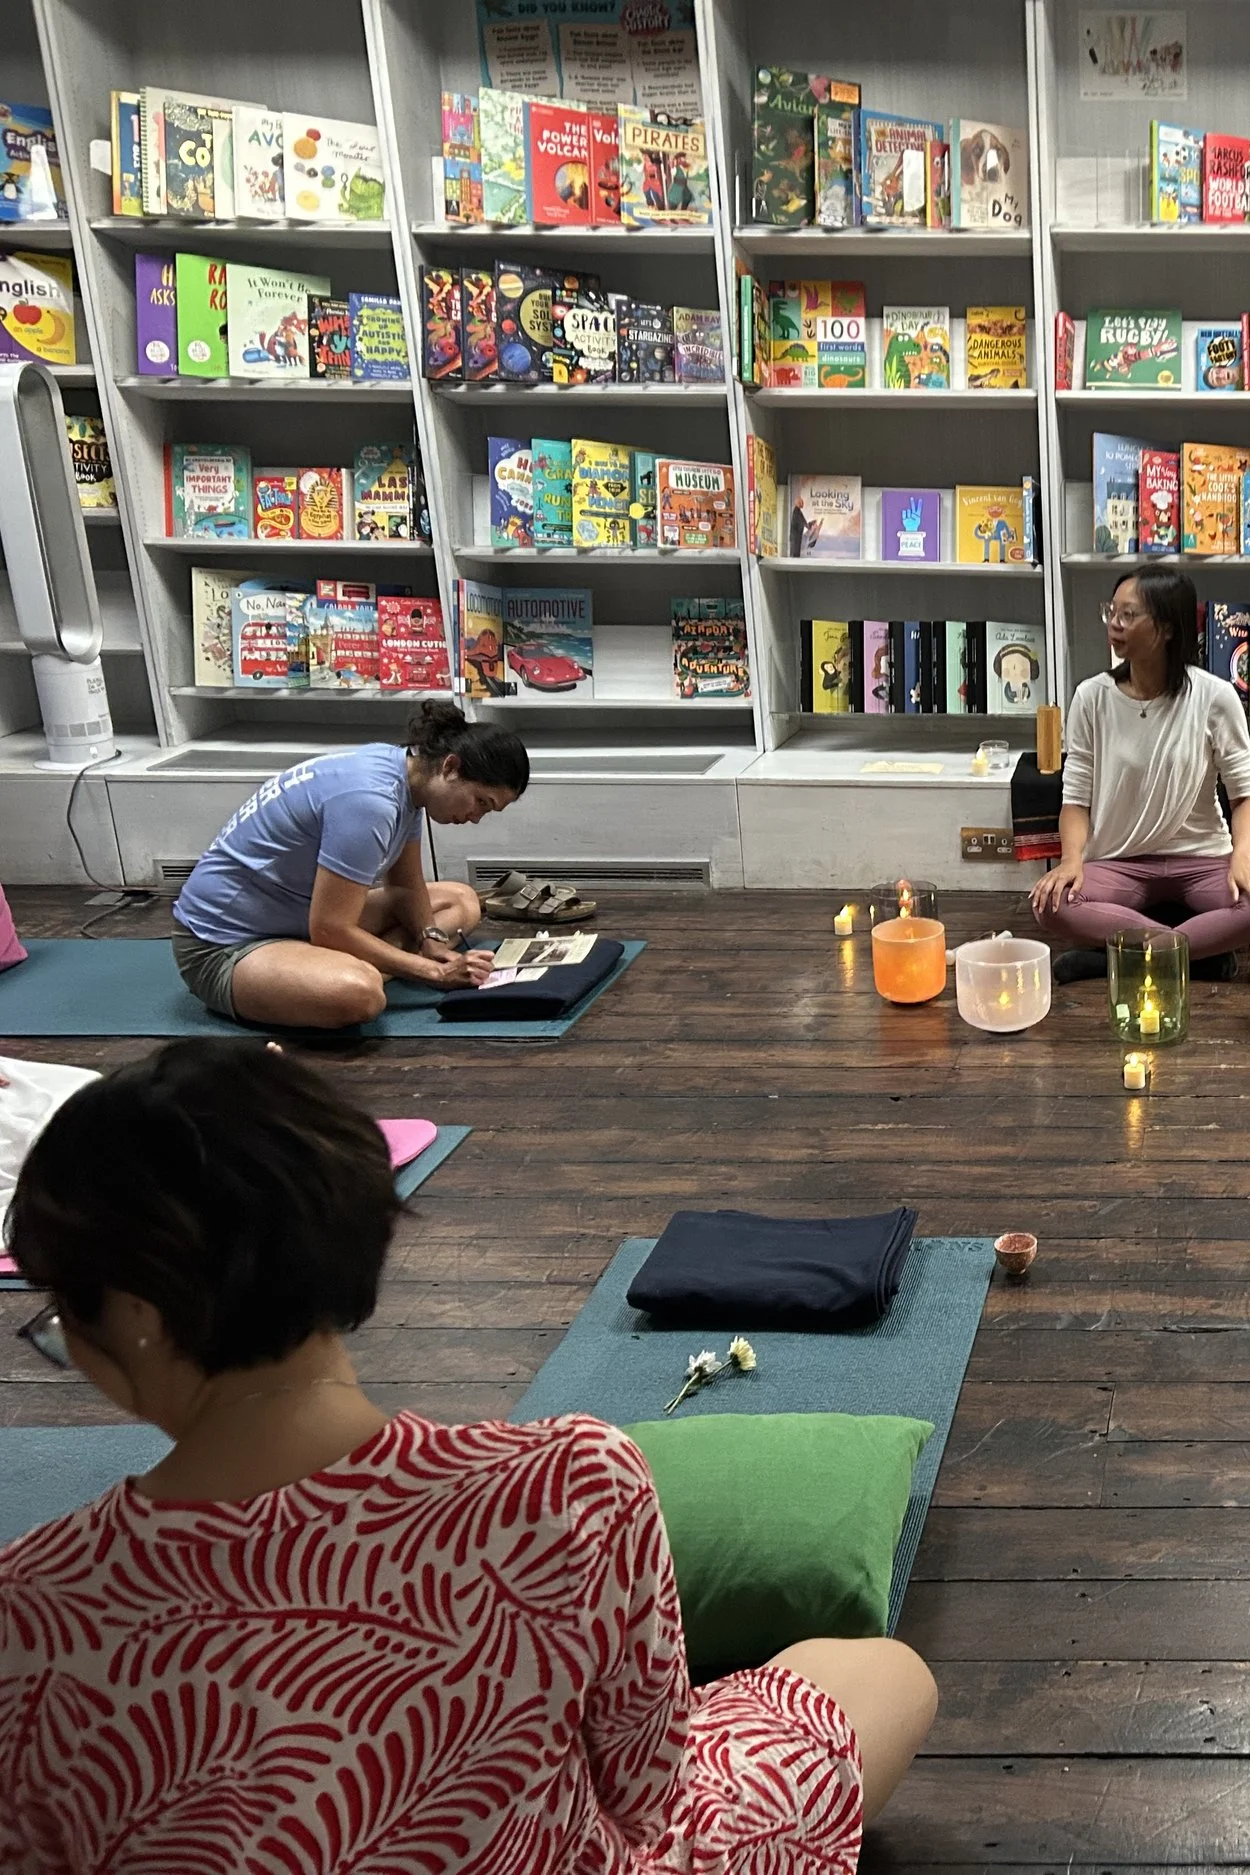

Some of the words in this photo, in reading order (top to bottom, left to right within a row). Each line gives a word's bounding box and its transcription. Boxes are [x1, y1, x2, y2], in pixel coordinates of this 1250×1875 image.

[564, 122, 588, 135] THE
[889, 128, 927, 141] ANIMAL
[542, 130, 588, 147] POWER
[632, 127, 700, 152] PIRATES
[1209, 176, 1246, 195] WORLD
[992, 199, 1022, 227] Dog
[248, 278, 258, 289] It
[260, 277, 294, 291] Won't
[297, 283, 311, 294] Be
[257, 289, 304, 303] Forever
[821, 319, 860, 340] 100
[1104, 315, 1135, 329] Let's
[1137, 316, 1167, 332] Play
[1100, 326, 1169, 347] RUGBY!
[820, 342, 836, 352] first
[838, 342, 862, 352] words
[973, 338, 1022, 350] DANGEROUS
[821, 353, 861, 363] dinosaurs
[977, 349, 1017, 361] ANIMALS
[198, 463, 220, 475] Very
[1146, 464, 1161, 478] MY
[186, 475, 232, 485] IMPORTANT
[675, 473, 720, 491] MUSEUM
[1146, 476, 1179, 491] BAKING
[1207, 472, 1217, 482] THE
[191, 483, 229, 495] THINGS
[810, 487, 850, 502] Looking
[834, 500, 854, 512] Sky
[962, 493, 991, 507] Vincent
[246, 600, 265, 612] No,
[507, 600, 586, 620] AUTOMOTIVE
[683, 623, 734, 635] AIRPORT
[382, 639, 419, 649] LONDON
[681, 657, 745, 677] ADVENTURE
